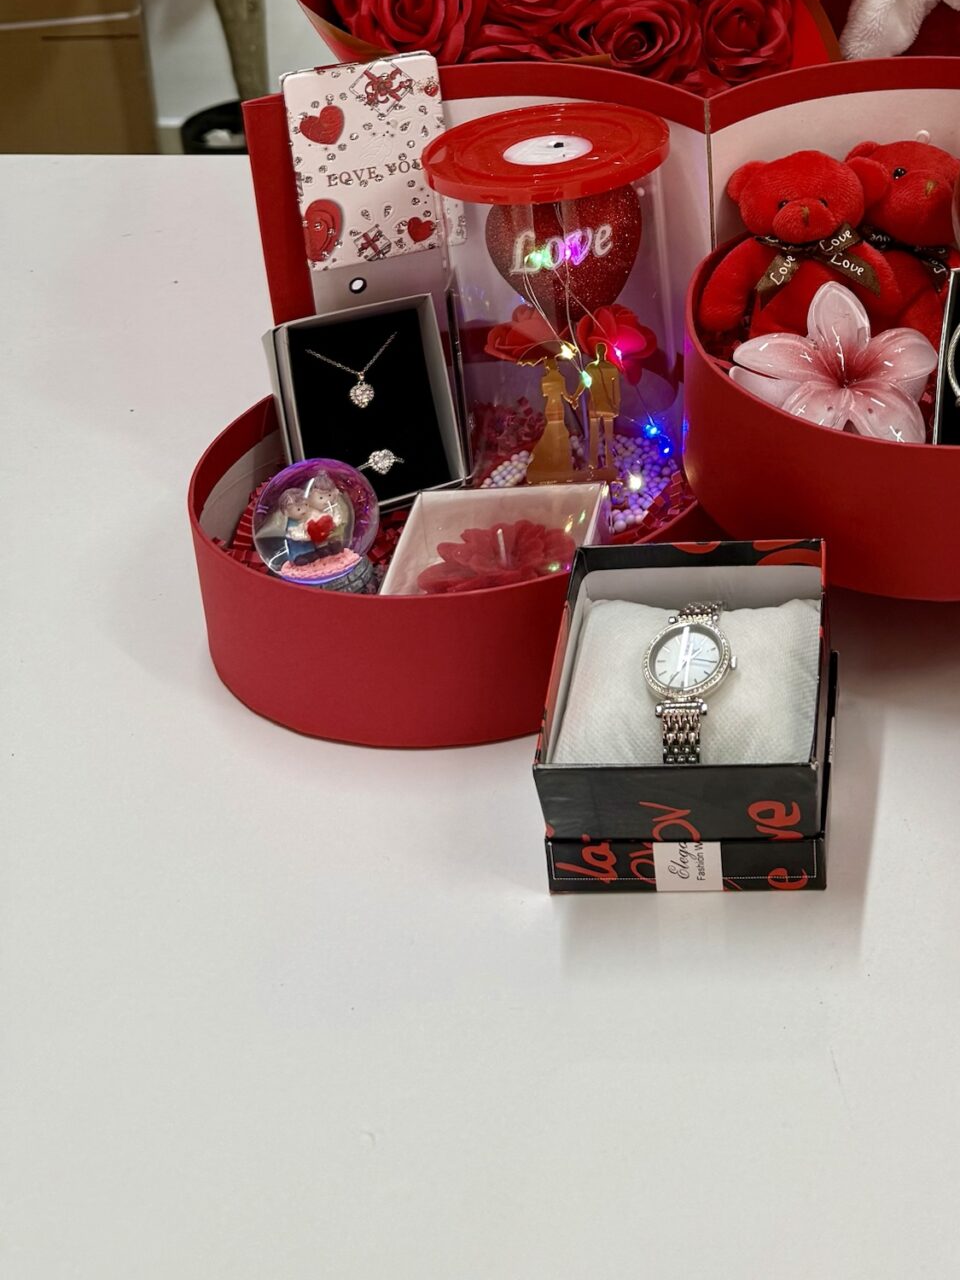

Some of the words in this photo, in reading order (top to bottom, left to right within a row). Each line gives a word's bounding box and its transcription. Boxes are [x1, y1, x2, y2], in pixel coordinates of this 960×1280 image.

[510, 224, 613, 276] Love
[819, 229, 852, 252] Love
[770, 255, 796, 286] Love
[830, 253, 865, 276] Love
